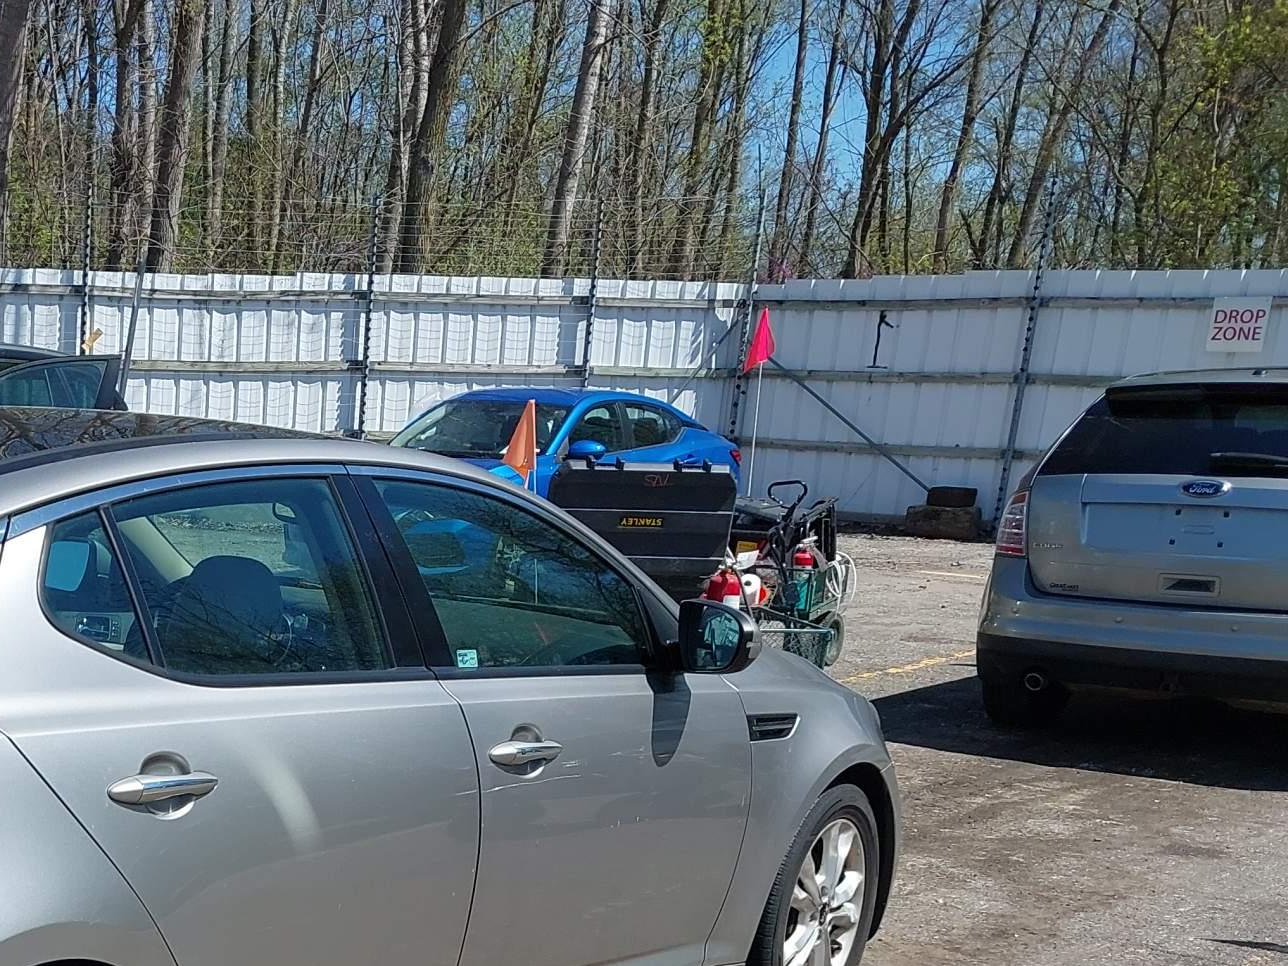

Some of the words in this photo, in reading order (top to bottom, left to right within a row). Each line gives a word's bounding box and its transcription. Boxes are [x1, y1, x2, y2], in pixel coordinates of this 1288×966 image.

[1213, 308, 1267, 324] DROP
[1210, 326, 1263, 341] ZONE
[1188, 483, 1218, 494] Ford
[620, 516, 664, 527] STANLEY
